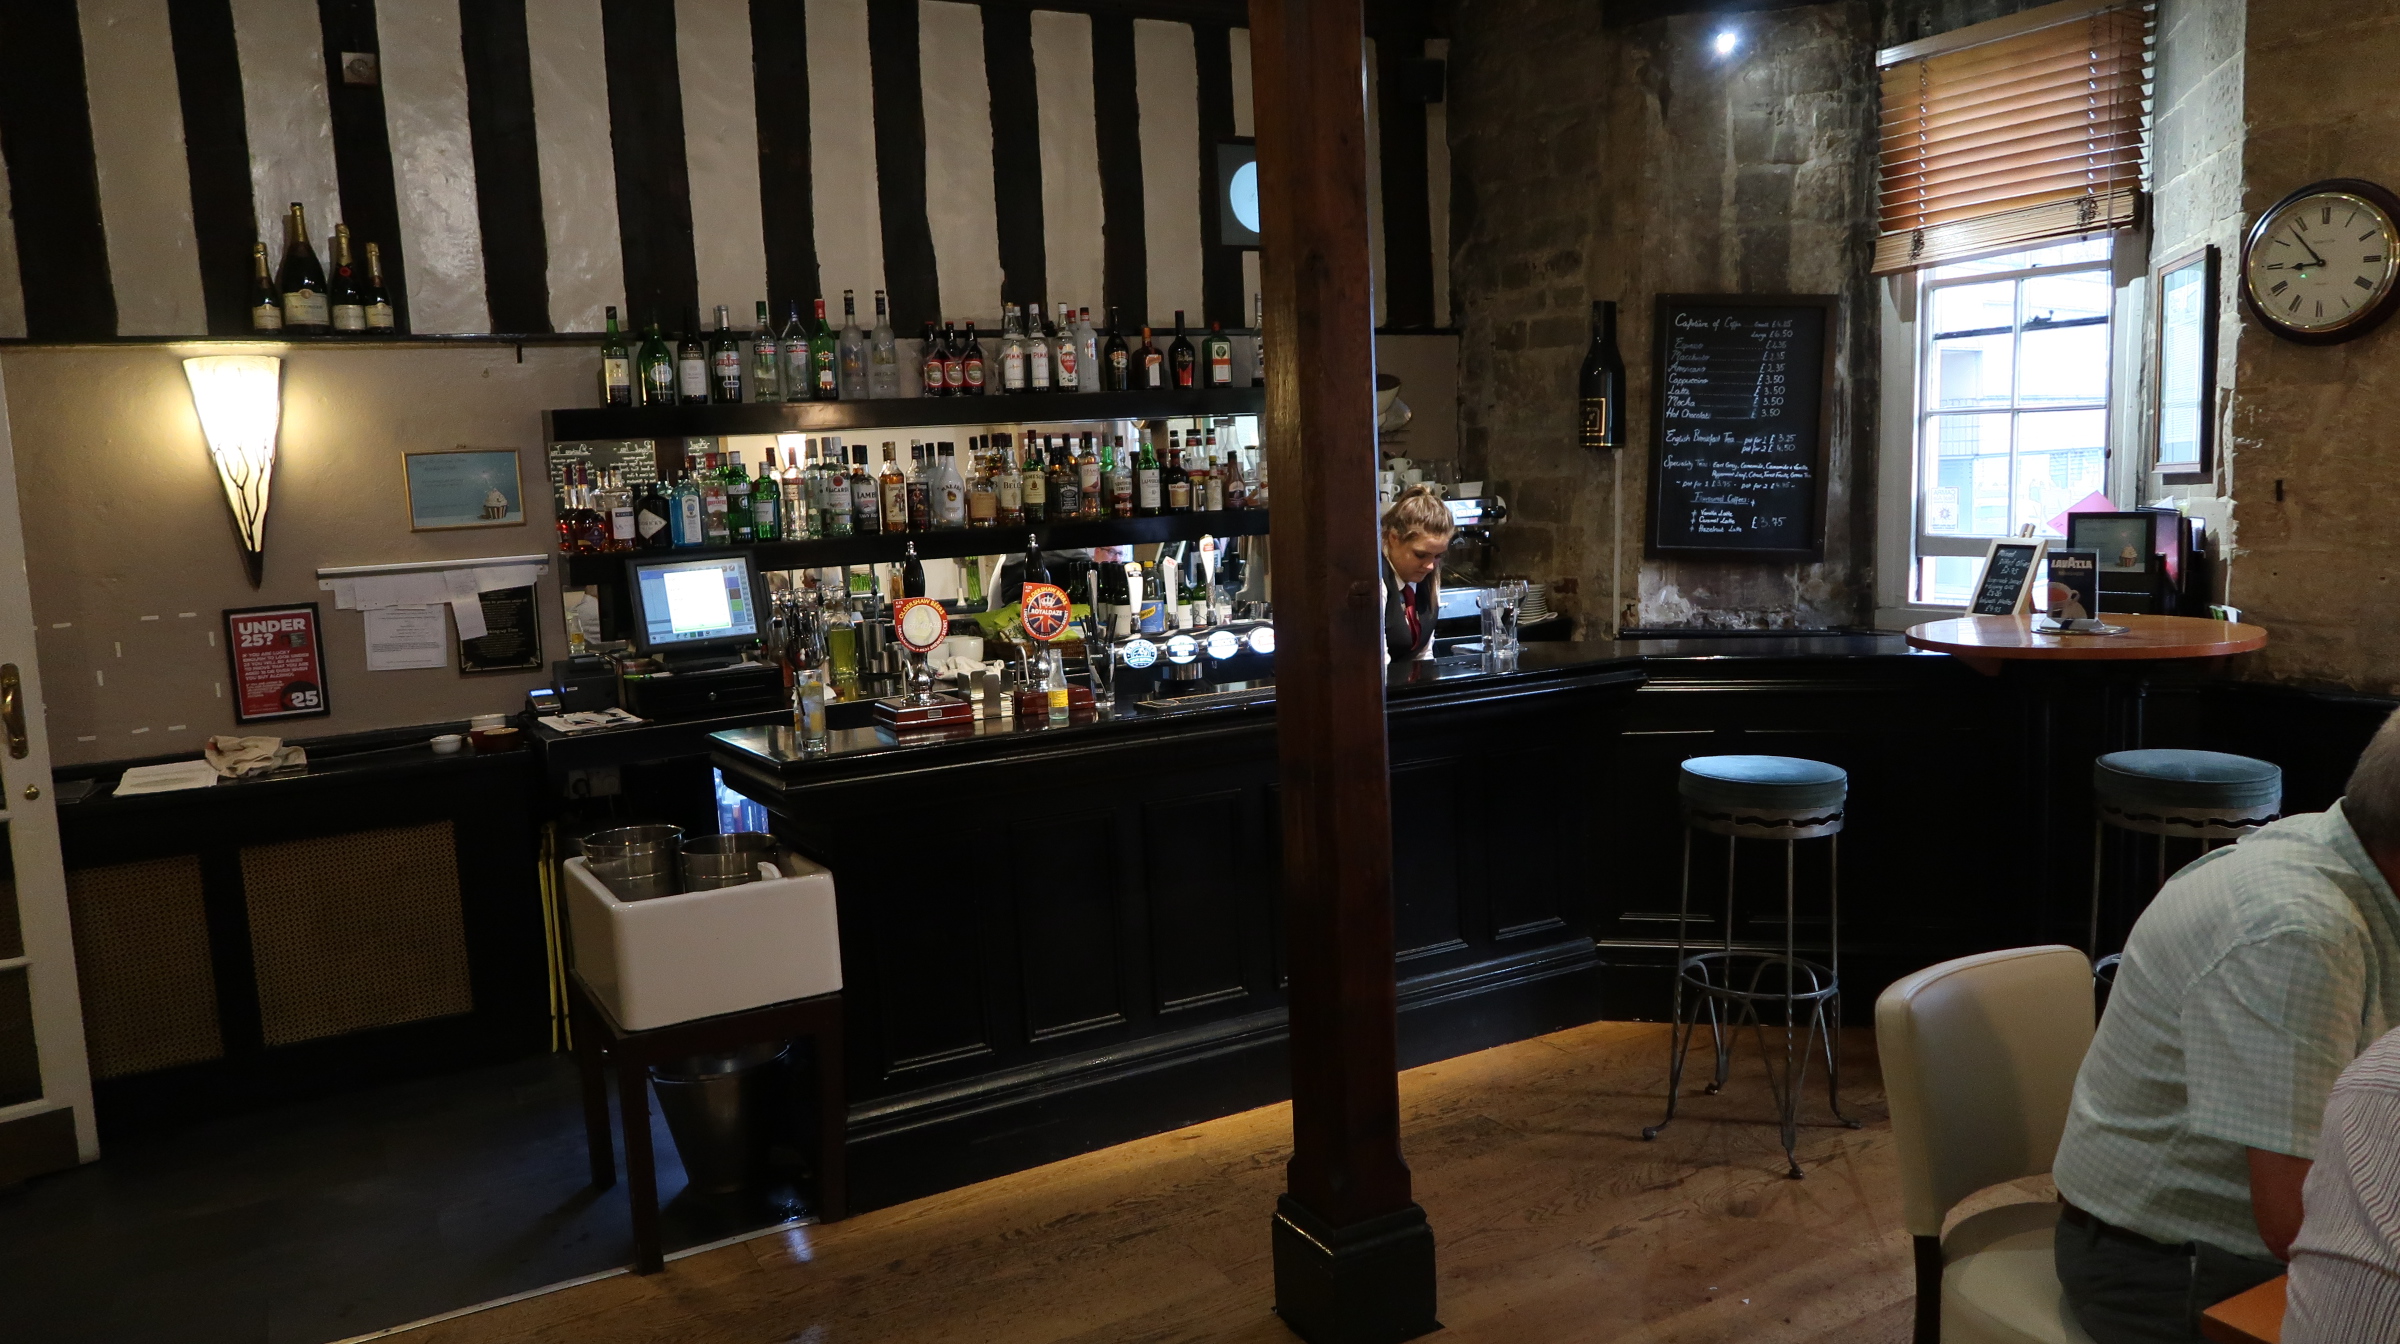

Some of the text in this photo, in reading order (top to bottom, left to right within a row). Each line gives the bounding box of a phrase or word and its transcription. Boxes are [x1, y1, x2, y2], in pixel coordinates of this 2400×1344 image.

[1769, 330, 1793, 338] £6.50
[1665, 408, 1680, 418] Hot
[1665, 428, 1690, 446] English
[2051, 556, 2093, 569] LAVAZZA
[1026, 587, 1068, 605] OLDERSHAW BEERS
[898, 598, 945, 619] OLDERSHAW BEERS
[1031, 608, 1062, 616] ROYALDAZE
[238, 618, 306, 634] UNDER
[241, 633, 274, 647] 25?
[291, 690, 319, 707] 25
